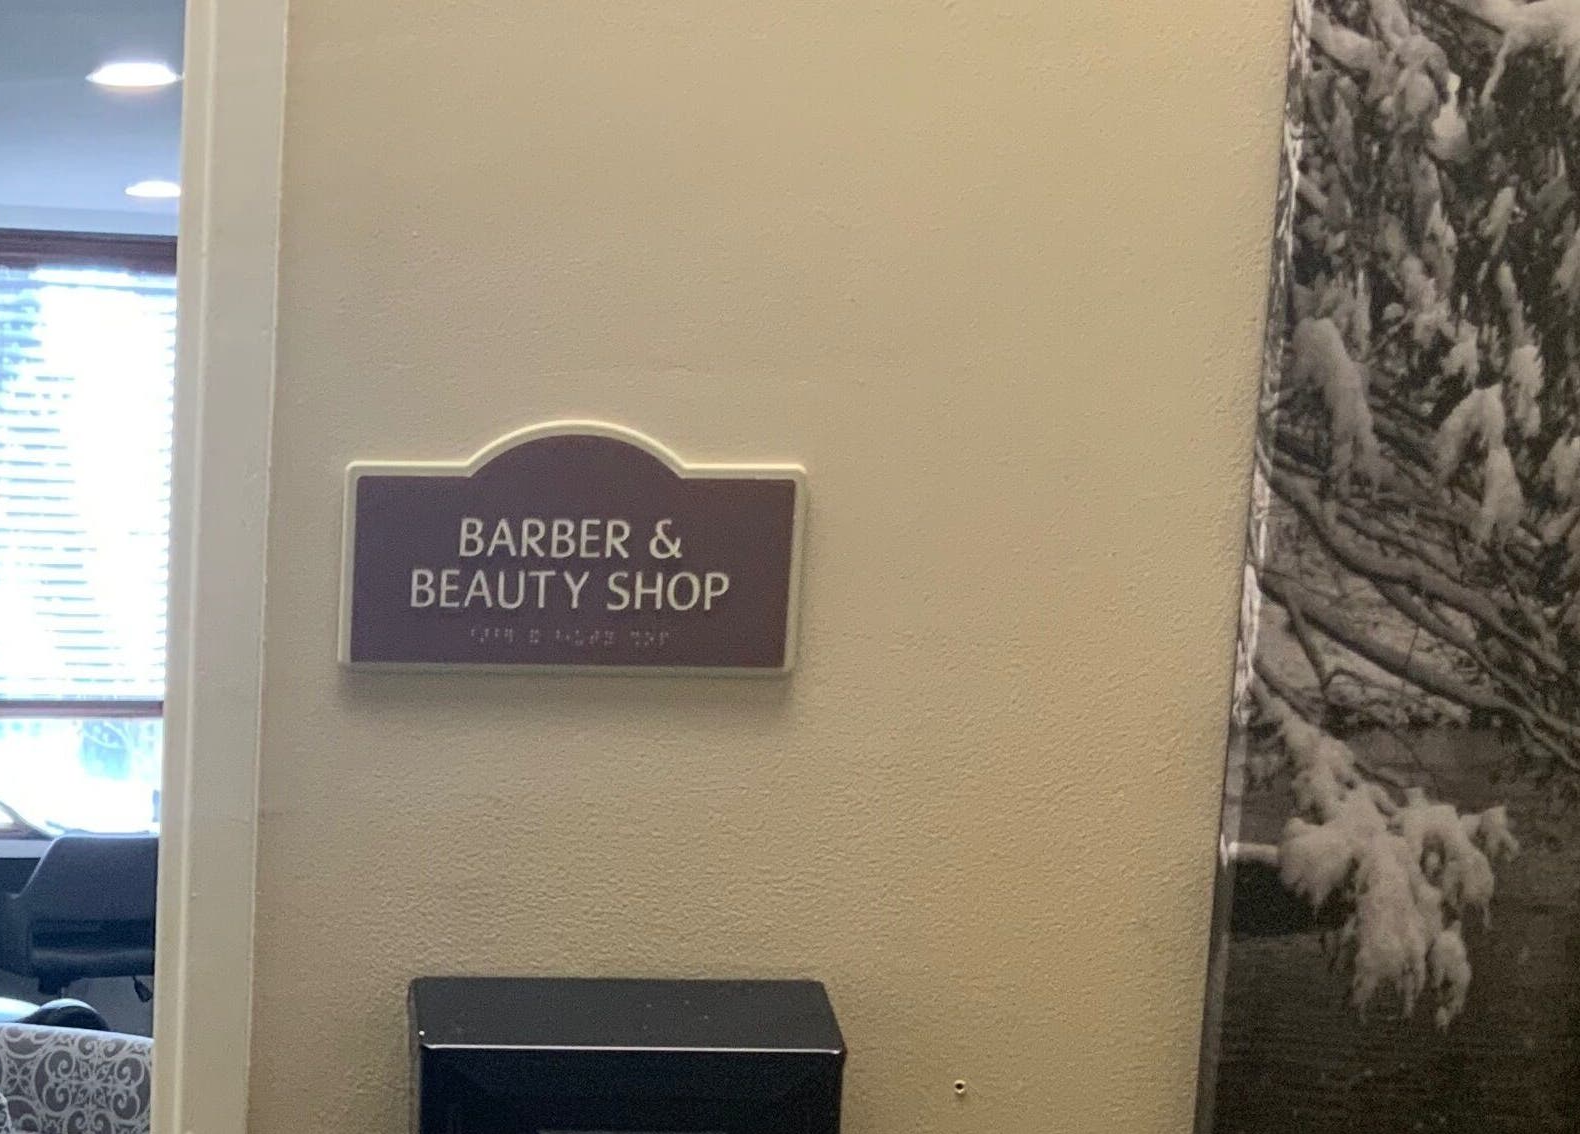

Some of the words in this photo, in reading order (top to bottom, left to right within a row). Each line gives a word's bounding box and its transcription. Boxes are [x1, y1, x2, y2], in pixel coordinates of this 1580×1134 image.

[458, 517, 632, 560] BARBER
[649, 518, 683, 560] &
[409, 568, 590, 609] BEAUTY
[606, 571, 730, 611] SHOP
